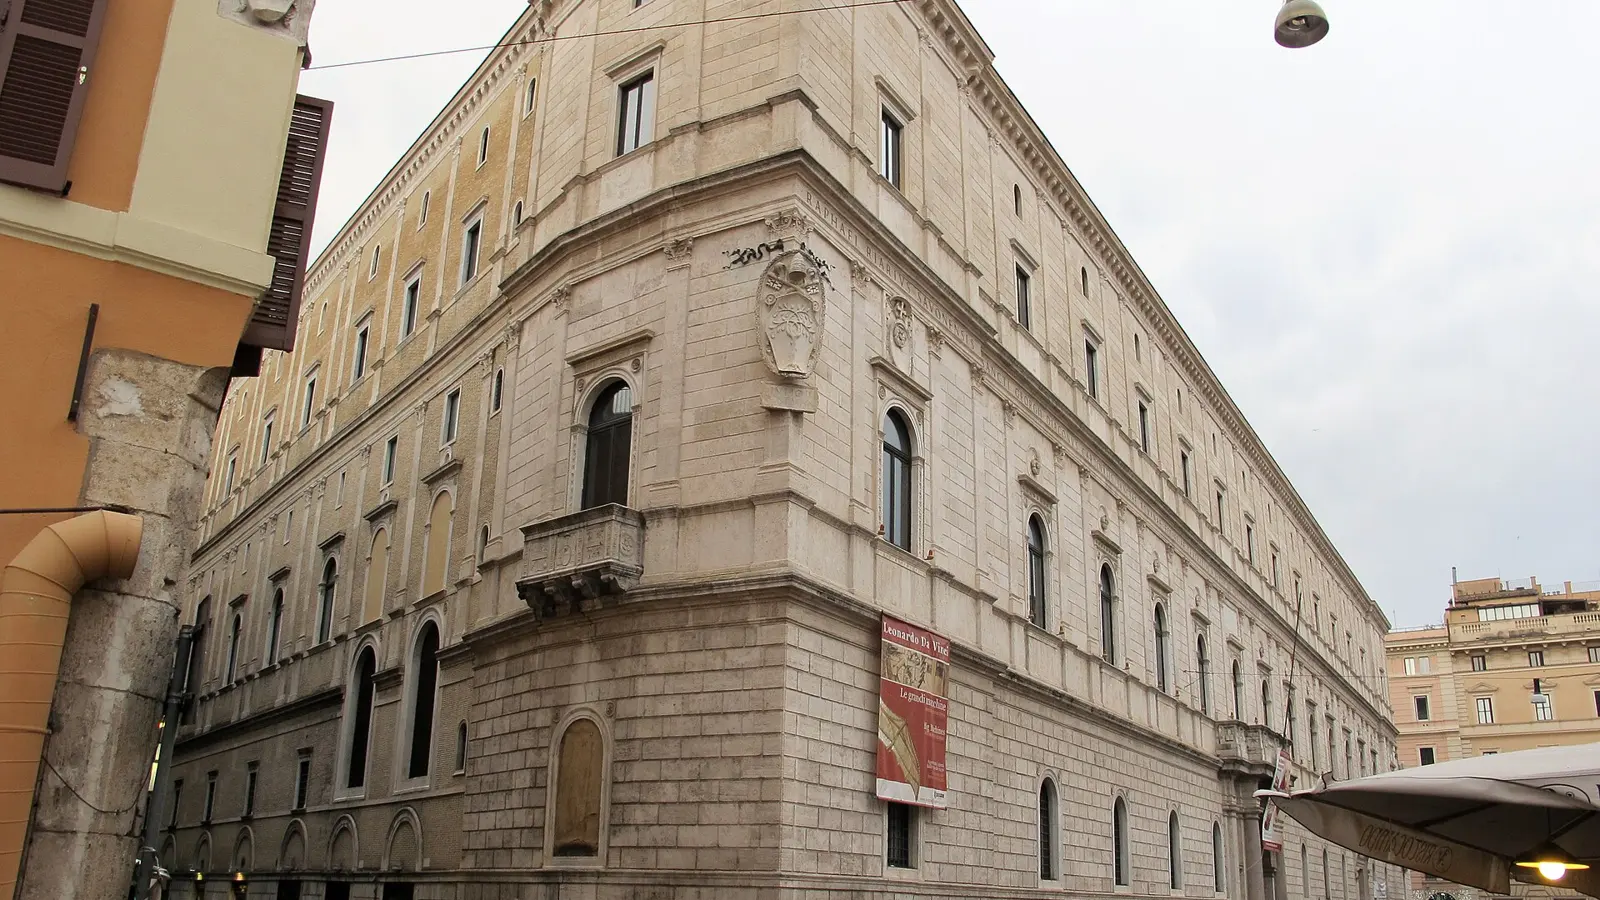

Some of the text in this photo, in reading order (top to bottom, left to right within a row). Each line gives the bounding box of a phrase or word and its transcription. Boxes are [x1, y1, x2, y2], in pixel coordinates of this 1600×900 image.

[882, 621, 949, 657] Leonardo Da Vinci
[899, 687, 908, 700] Le
